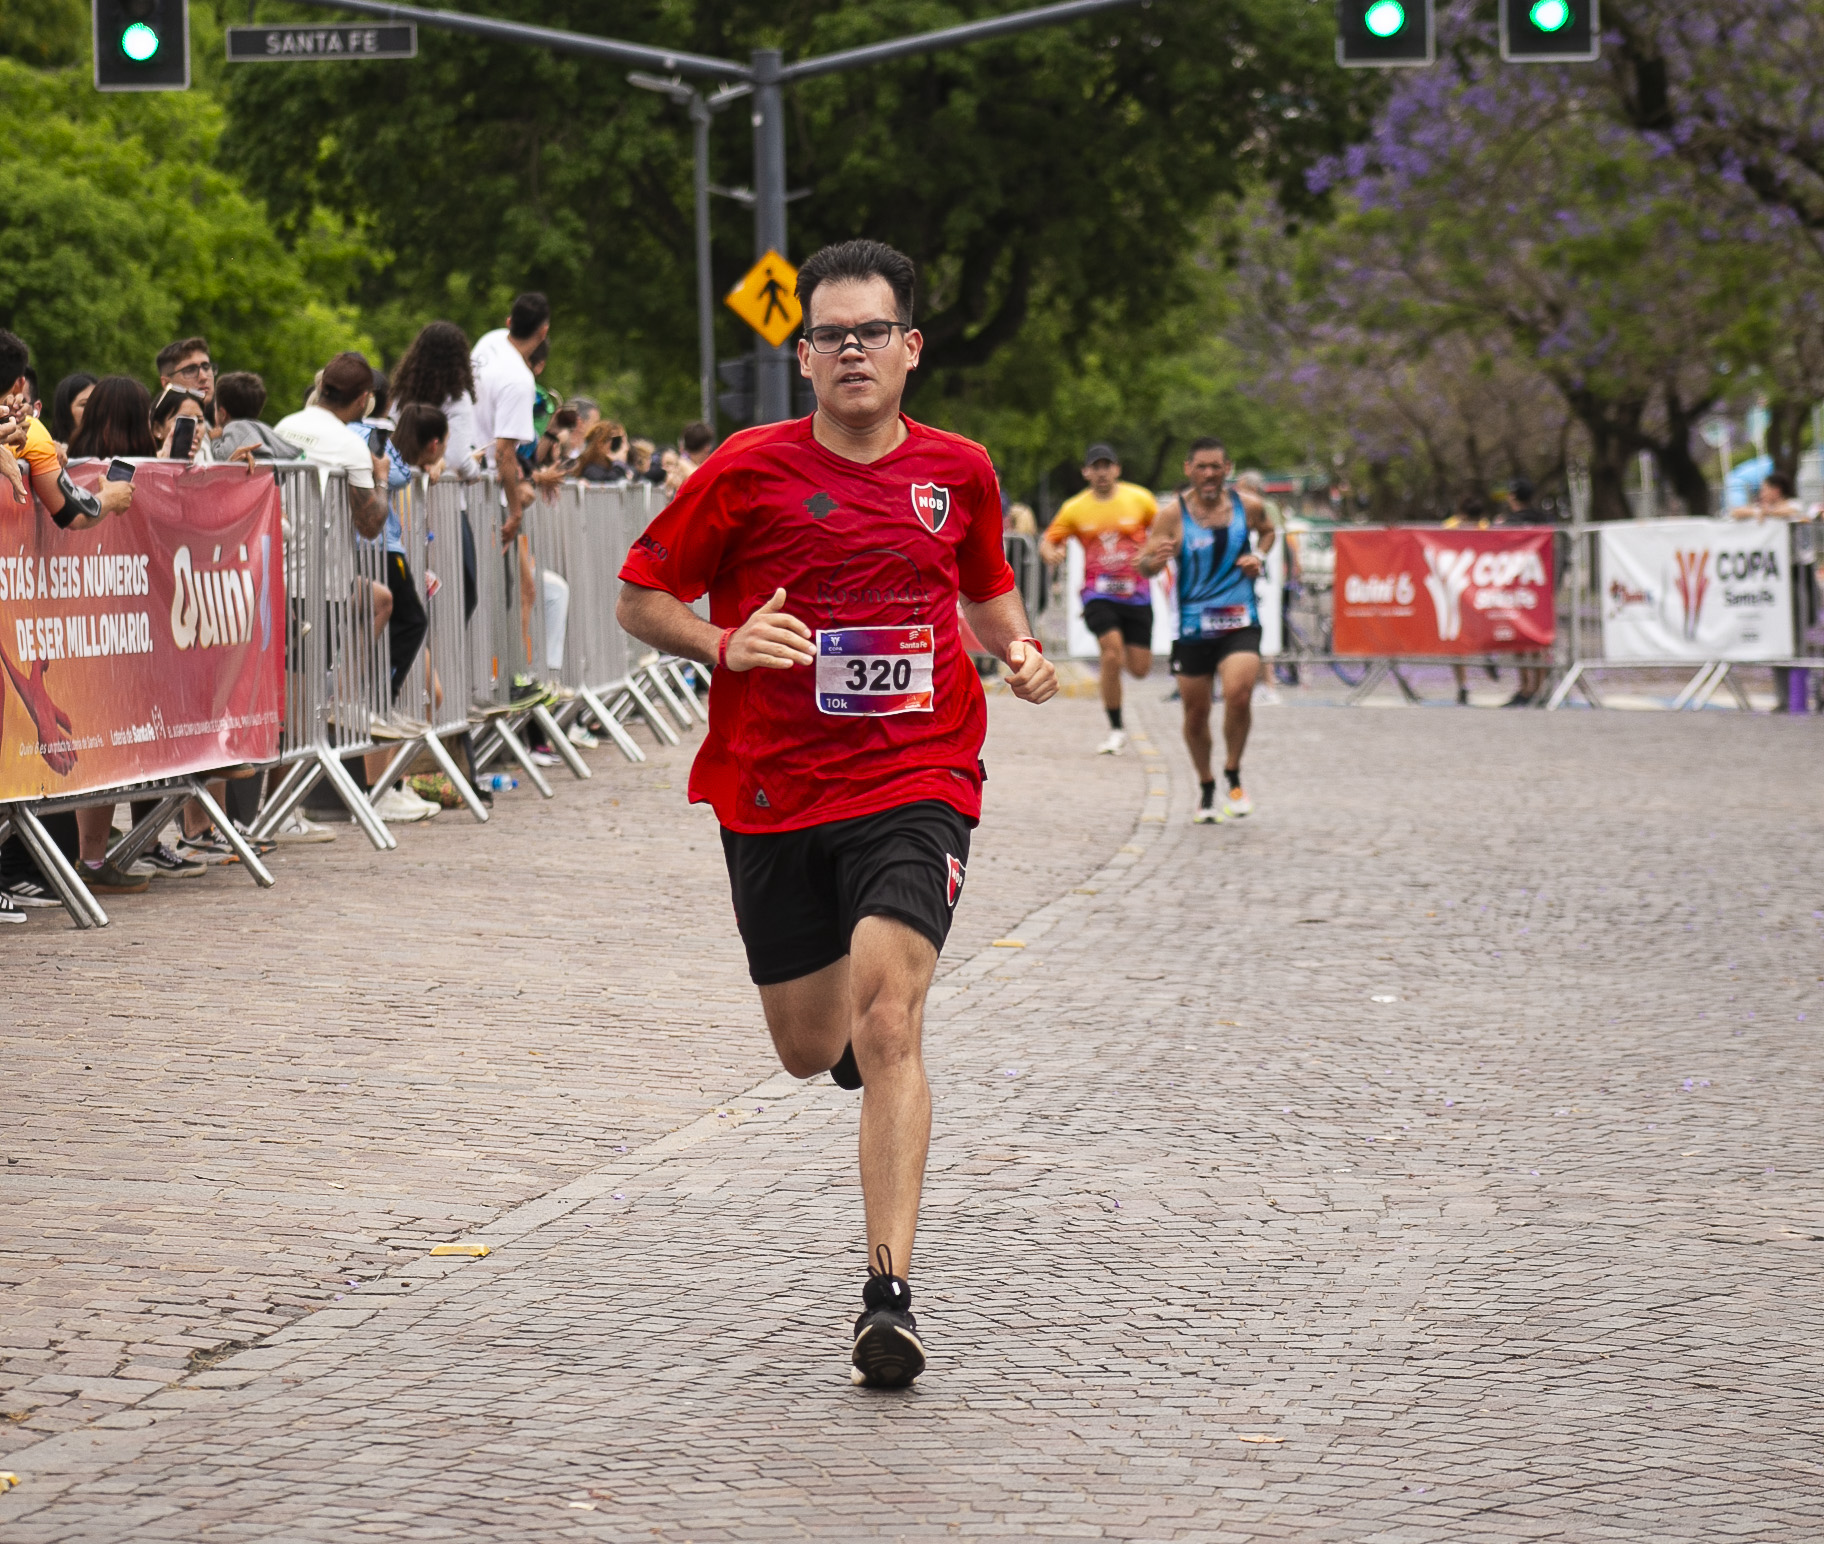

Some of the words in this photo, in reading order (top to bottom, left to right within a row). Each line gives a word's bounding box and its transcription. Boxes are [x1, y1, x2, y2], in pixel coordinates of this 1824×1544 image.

[266, 31, 343, 55] SANTA
[348, 30, 379, 53] FE
[918, 496, 944, 511] NOB
[37, 557, 49, 600] A
[49, 555, 81, 599] SEIS
[83, 543, 149, 598] NÚMEROS
[1472, 551, 1547, 588] COPA
[1716, 551, 1779, 581] COPA
[170, 543, 255, 651] Quini
[1395, 572, 1416, 606] 6
[16, 617, 37, 662] DE
[37, 614, 64, 661] SER
[66, 612, 153, 659] MILLONARIO.
[845, 659, 912, 691] 320
[826, 698, 848, 709] 10k
[20, 742, 35, 758] Quini
[34, 740, 40, 755] 6
[40, 741, 47, 754] es
